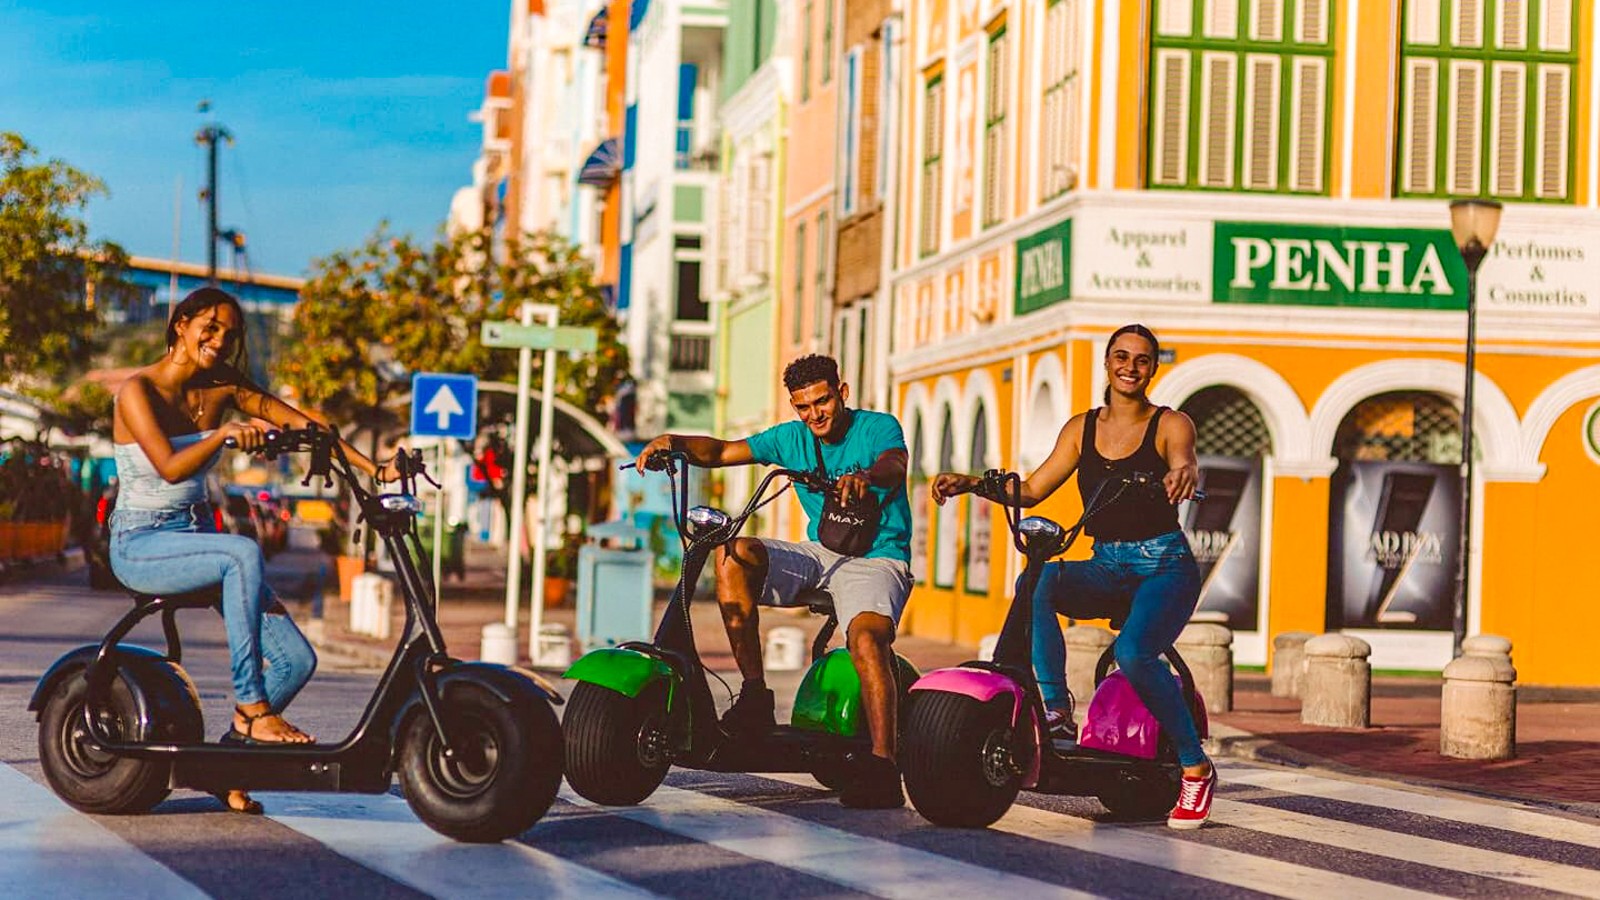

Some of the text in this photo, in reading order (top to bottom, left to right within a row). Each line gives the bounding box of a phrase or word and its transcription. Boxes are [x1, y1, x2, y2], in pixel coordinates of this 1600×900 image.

[1105, 227, 1187, 250] Apparel
[1135, 251, 1152, 268] &
[1494, 240, 1585, 261] Perfumes
[1229, 236, 1455, 296] PENHA
[1529, 265, 1545, 282] &
[1088, 272, 1202, 293] Accessories
[1488, 285, 1588, 305] Cosmetics
[828, 512, 865, 526] MAX
